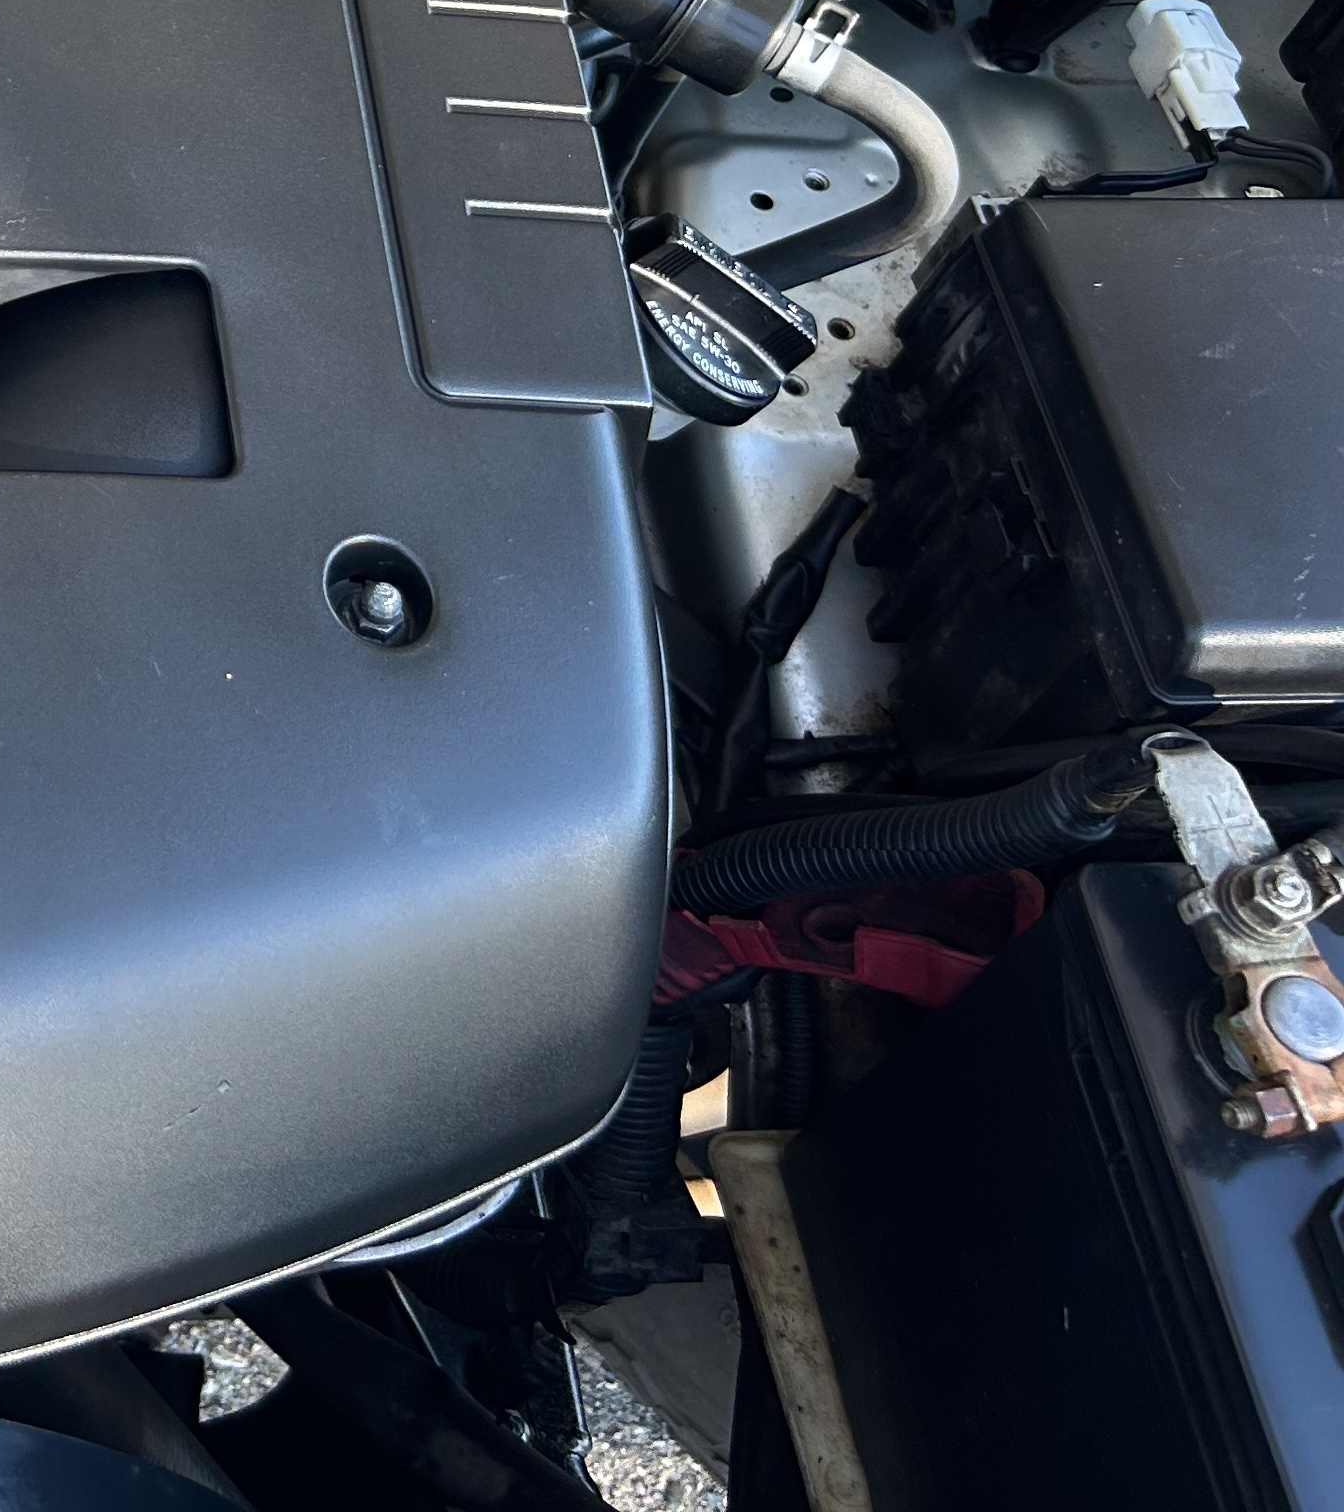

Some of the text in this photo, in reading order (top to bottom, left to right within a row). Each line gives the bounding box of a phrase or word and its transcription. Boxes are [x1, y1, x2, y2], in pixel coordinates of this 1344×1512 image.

[645, 300, 765, 396] ENERGY CONSERVING
[671, 314, 741, 375] SAE 5W-30
[685, 310, 730, 351] API SL
